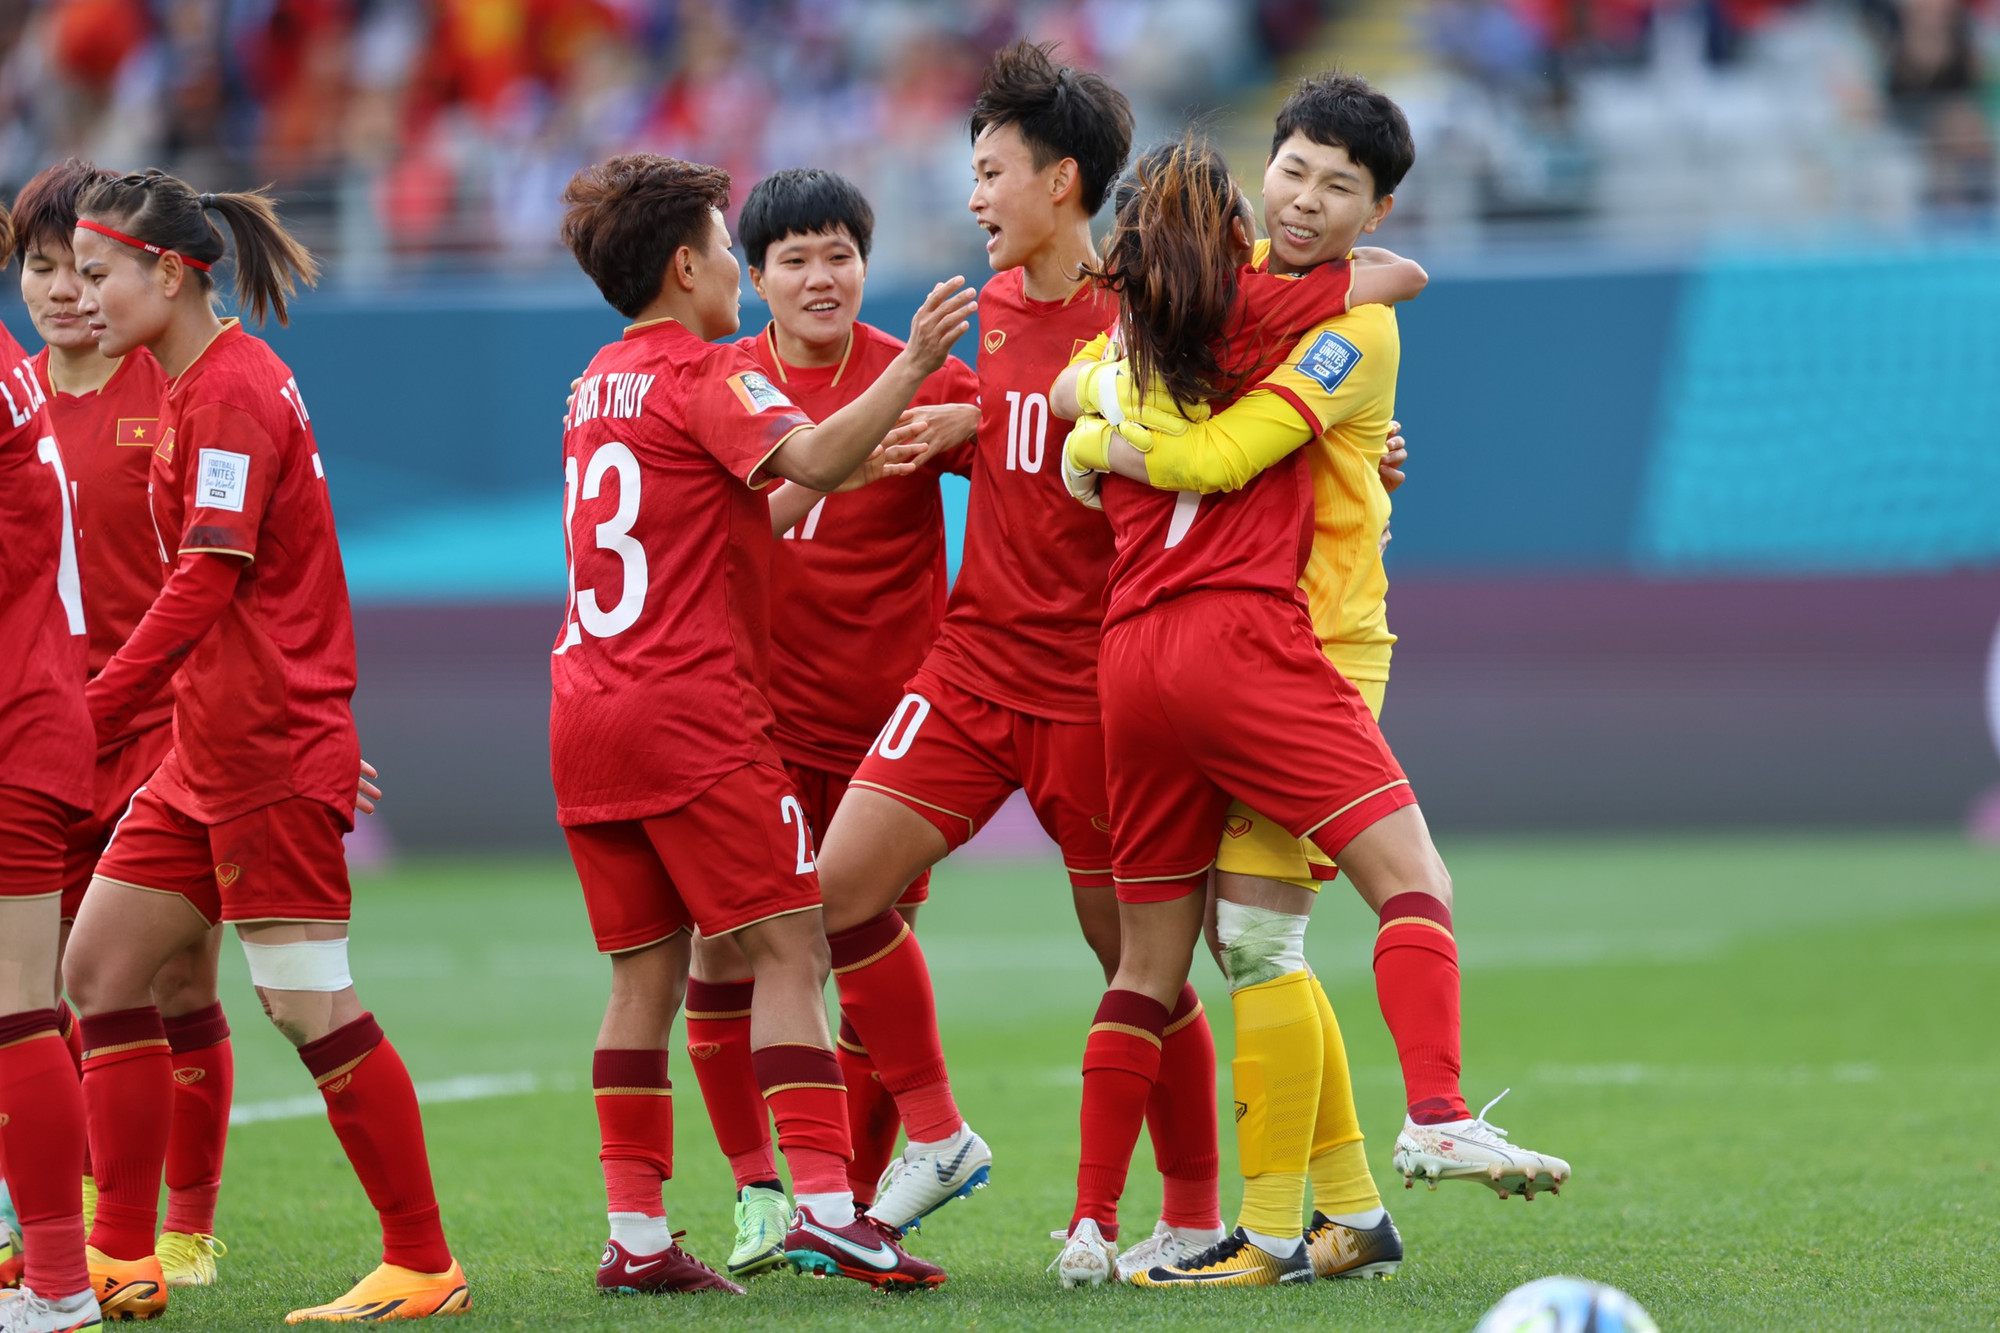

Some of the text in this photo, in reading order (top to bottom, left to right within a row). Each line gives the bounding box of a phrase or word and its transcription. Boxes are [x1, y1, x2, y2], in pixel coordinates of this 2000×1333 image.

[144, 243, 160, 254] NIKE
[1319, 345, 1346, 367] UNITES
[1325, 338, 1350, 360] FOOTBALL
[602, 372, 656, 419] THUY
[1005, 390, 1048, 474] 10
[208, 467, 236, 481] UNITES
